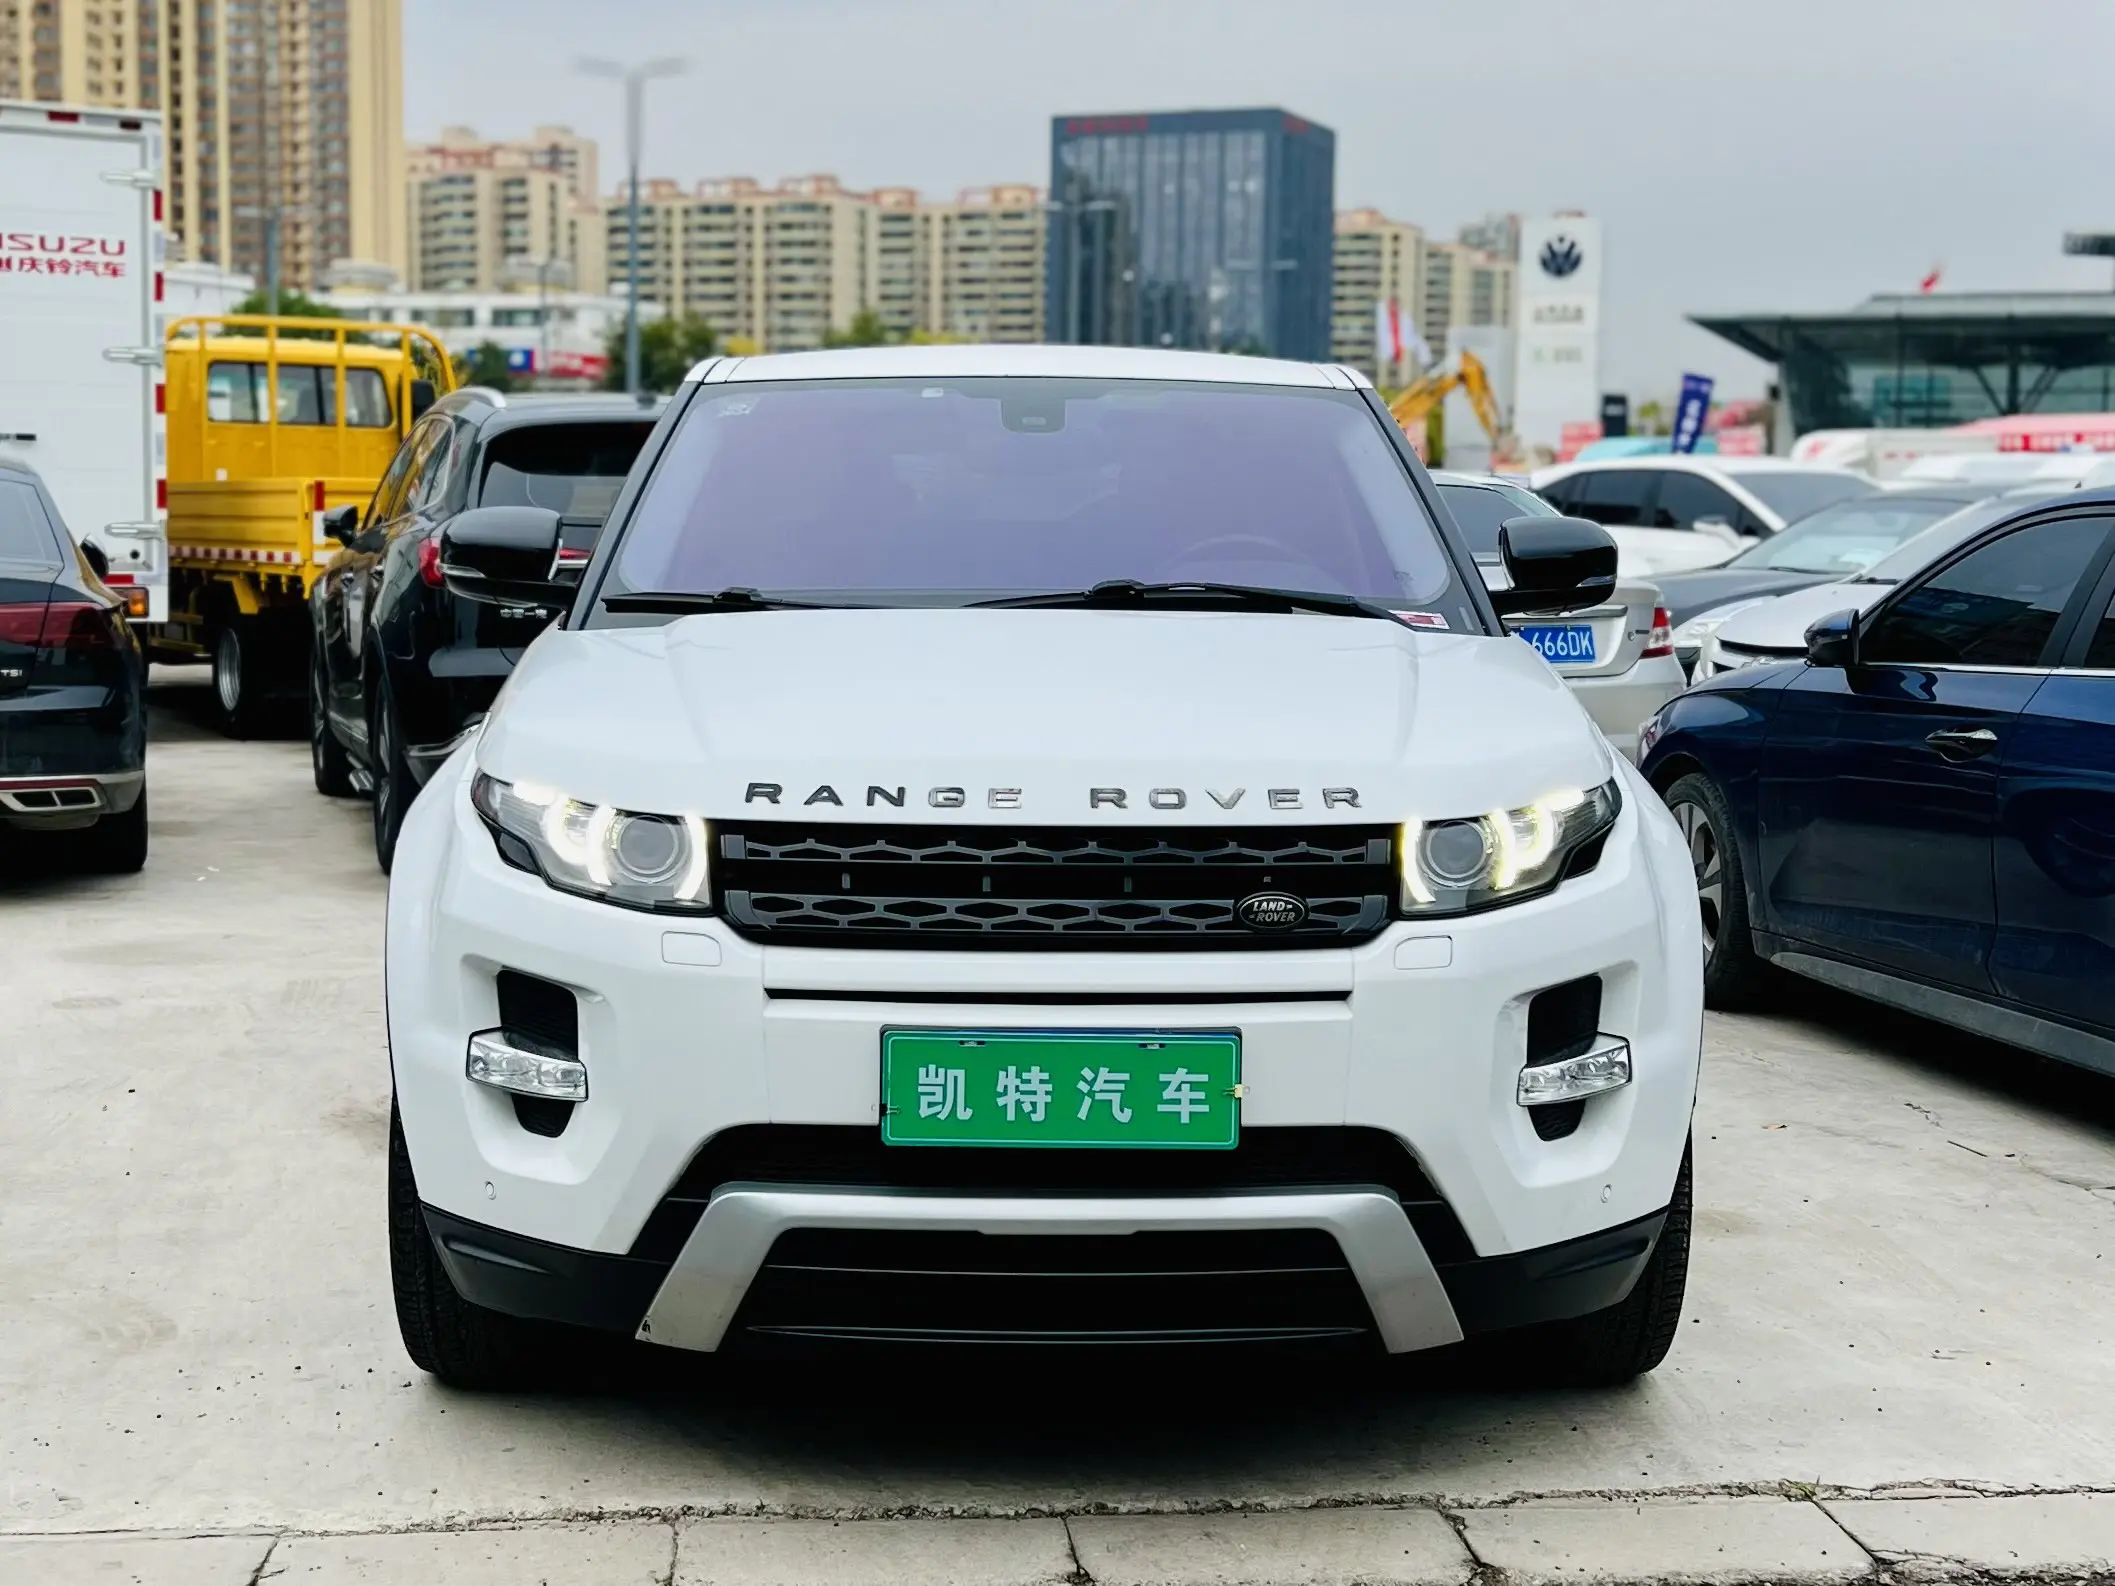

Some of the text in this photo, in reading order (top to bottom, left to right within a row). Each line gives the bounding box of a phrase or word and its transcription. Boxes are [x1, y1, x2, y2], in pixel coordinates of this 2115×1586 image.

[744, 782, 1362, 810] RANGE ROVER
[917, 1064, 1210, 1124] 凯特汽车
